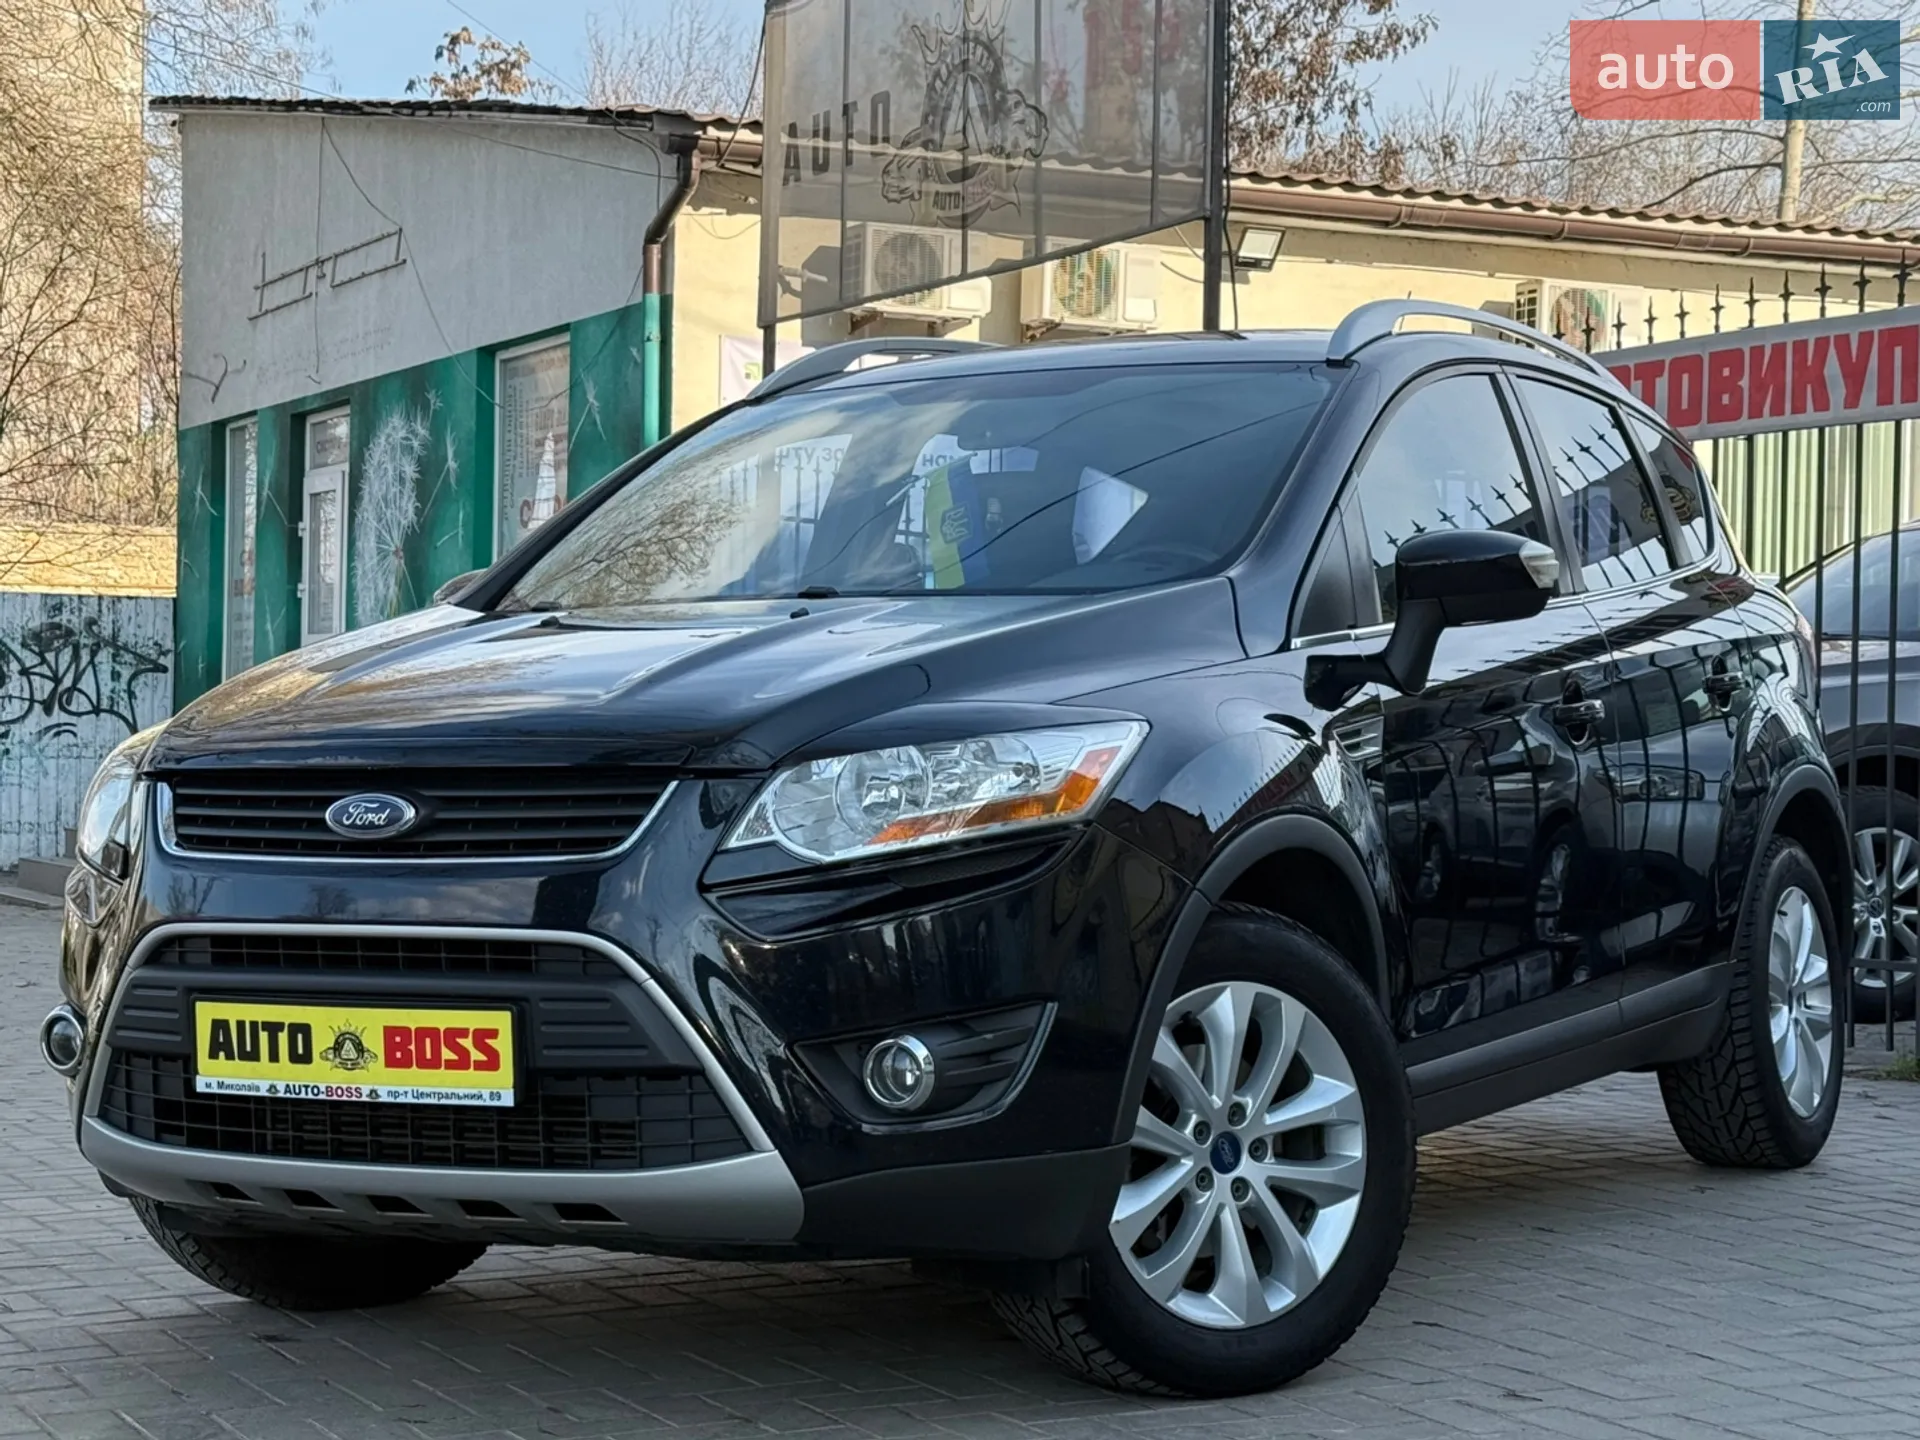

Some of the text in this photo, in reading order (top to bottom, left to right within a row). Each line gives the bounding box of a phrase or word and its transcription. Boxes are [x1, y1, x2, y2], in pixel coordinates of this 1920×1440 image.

[781, 90, 891, 187] AUTO
[1607, 324, 1919, 428] ТОВИКУП
[342, 802, 391, 826] Ford
[208, 1018, 501, 1072] AUTO BOSS
[283, 1083, 363, 1100] AUTO-BOSS
[488, 1090, 502, 1102] 89
